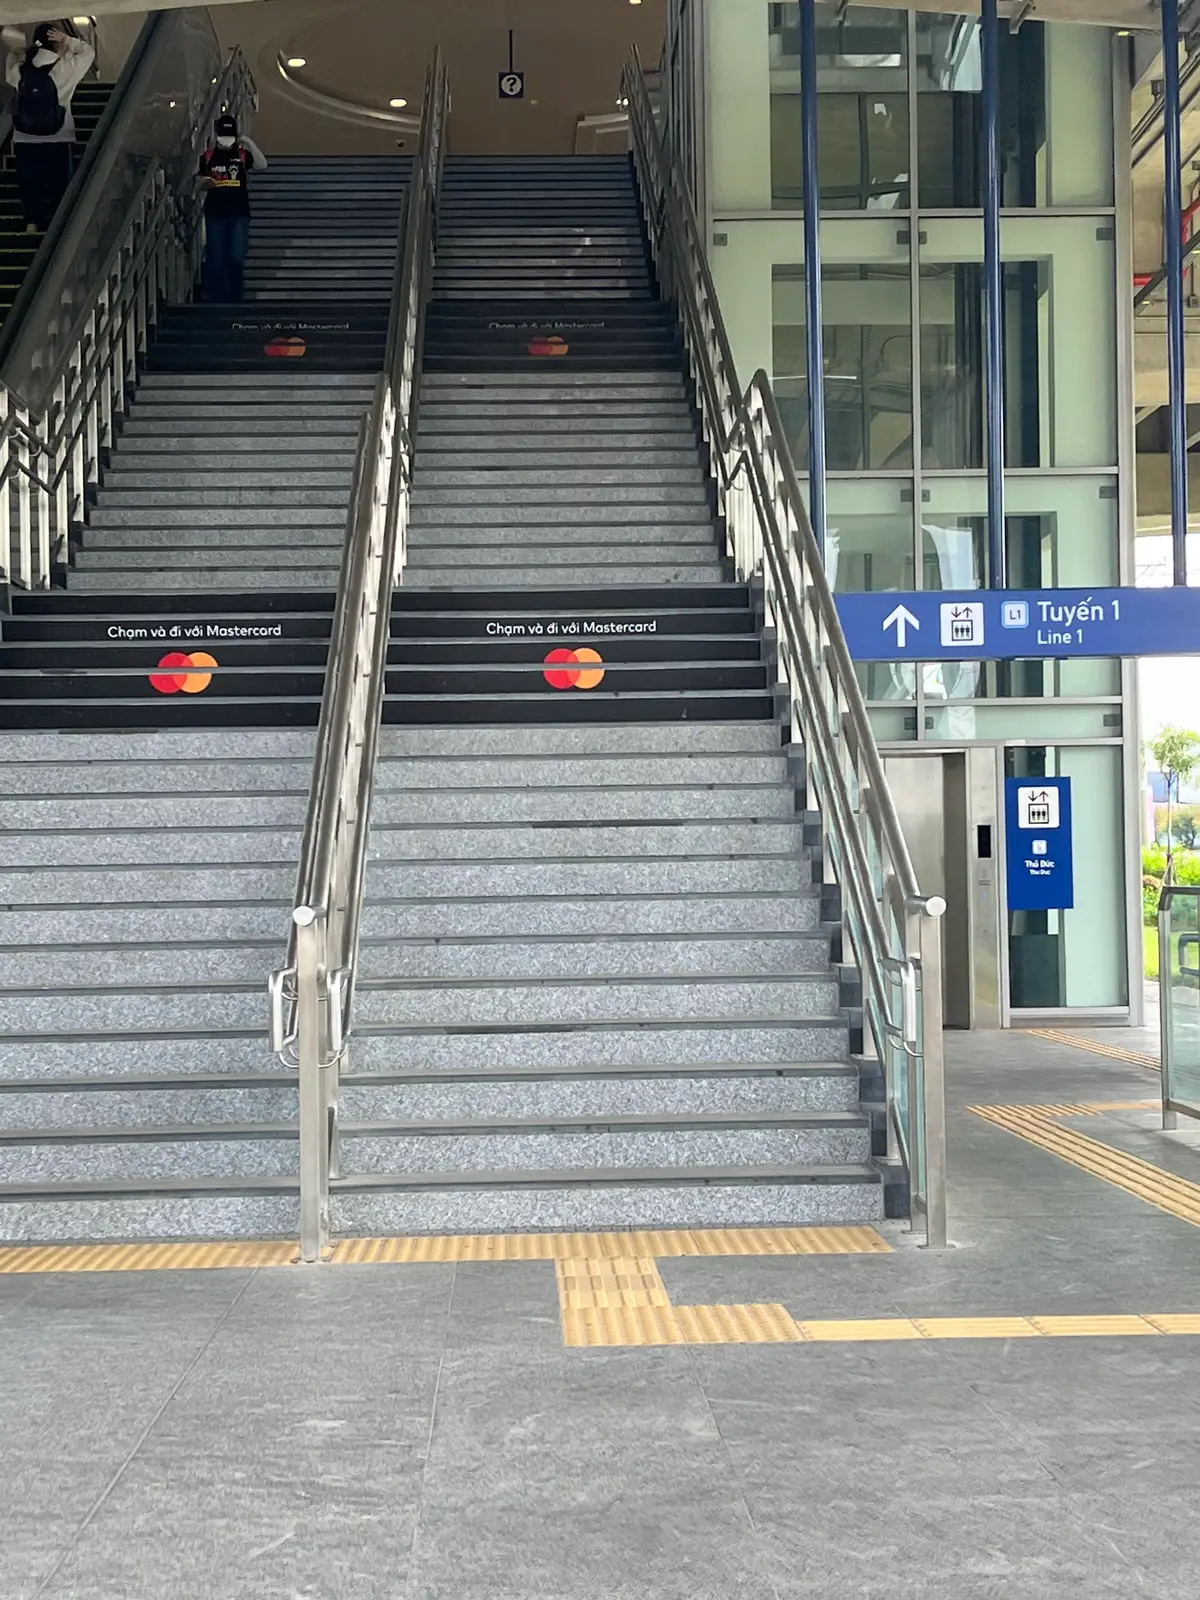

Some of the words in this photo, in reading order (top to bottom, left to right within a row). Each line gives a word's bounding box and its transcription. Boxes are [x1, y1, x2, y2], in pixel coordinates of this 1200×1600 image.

[1009, 609, 1021, 620] L1
[1037, 597, 1104, 627] Tuyến
[1111, 600, 1120, 621] 1
[107, 625, 148, 640] Chạm
[150, 625, 166, 638] và
[169, 624, 182, 638] đi
[184, 624, 204, 637] với
[206, 623, 282, 637] Mastercard
[486, 622, 525, 637] Chạm
[528, 621, 543, 634] và
[546, 621, 559, 634] đi
[561, 621, 580, 634] với
[583, 620, 657, 633] Mastercard
[1037, 629, 1072, 645] Line
[1076, 629, 1084, 644] 1
